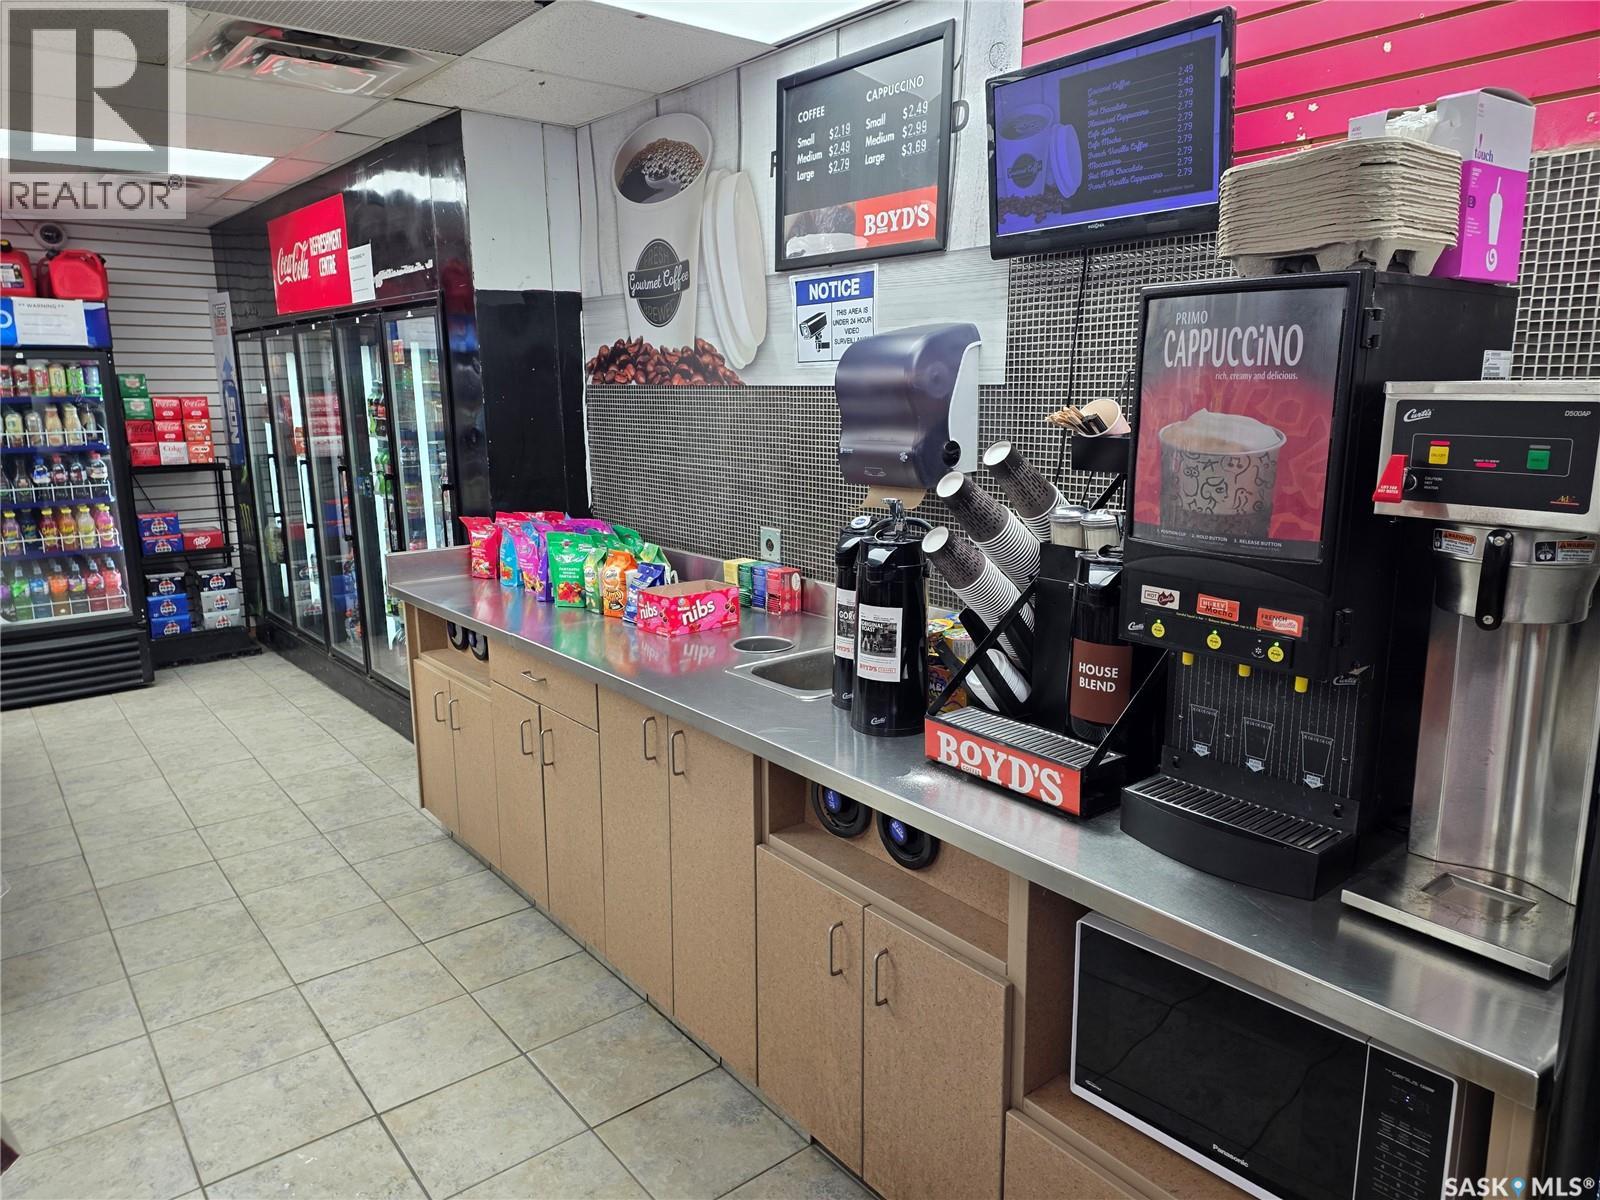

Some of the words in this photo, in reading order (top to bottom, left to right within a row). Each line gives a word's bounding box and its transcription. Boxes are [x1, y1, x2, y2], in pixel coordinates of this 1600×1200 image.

[1178, 64, 1194, 76] 2.49
[866, 75, 924, 102] CAPPUCCINO
[1178, 76, 1193, 87] 2.49
[1178, 88, 1193, 98] 2.79
[1178, 100, 1193, 110] 2.79
[798, 106, 824, 124] COFFEE
[866, 113, 886, 130] Small
[902, 101, 928, 120] $2.49
[1178, 112, 1193, 122] 2.79
[797, 133, 815, 148] Small
[829, 122, 851, 140] $2.19
[865, 132, 894, 147] Medium
[902, 120, 927, 138] $2.99
[1178, 122, 1193, 133] 2.79
[1178, 134, 1192, 144] 2.79
[797, 150, 822, 165] Medium
[829, 140, 850, 158] $2.49
[865, 153, 885, 166] Large
[902, 139, 926, 158] $3.69
[1178, 146, 1192, 156] 2.79
[1474, 148, 1493, 162] touch
[1178, 156, 1192, 166] 2.79
[797, 168, 814, 182] Large
[828, 158, 850, 175] $2.79
[1177, 167, 1192, 177] 2.79
[864, 203, 930, 236] BOYD'S
[309, 228, 342, 256] REFRESHMENT
[318, 254, 337, 277] CENTRE
[629, 274, 662, 296] Gourmet
[663, 264, 688, 292] Coffee
[809, 278, 860, 300] NOTICE
[833, 317, 850, 326] UNDER
[857, 316, 872, 324] HOUR
[1176, 310, 1208, 326] PRIMO
[1230, 372, 1252, 382] creamy
[1253, 372, 1266, 380] and
[1267, 371, 1298, 380] delicious.
[228, 398, 241, 444] NOS
[1404, 408, 1432, 422] Curtis
[640, 601, 658, 620] nibs
[682, 599, 716, 626] nibs
[1205, 606, 1233, 618] Mocha
[1079, 662, 1118, 679] HOUSE
[1079, 678, 1116, 693] BLEND
[1332, 676, 1357, 686] Curtis
[937, 730, 1064, 807] BOYD'S
[962, 766, 980, 775] COFFEE
[1212, 1143, 1248, 1168] Panasonic
